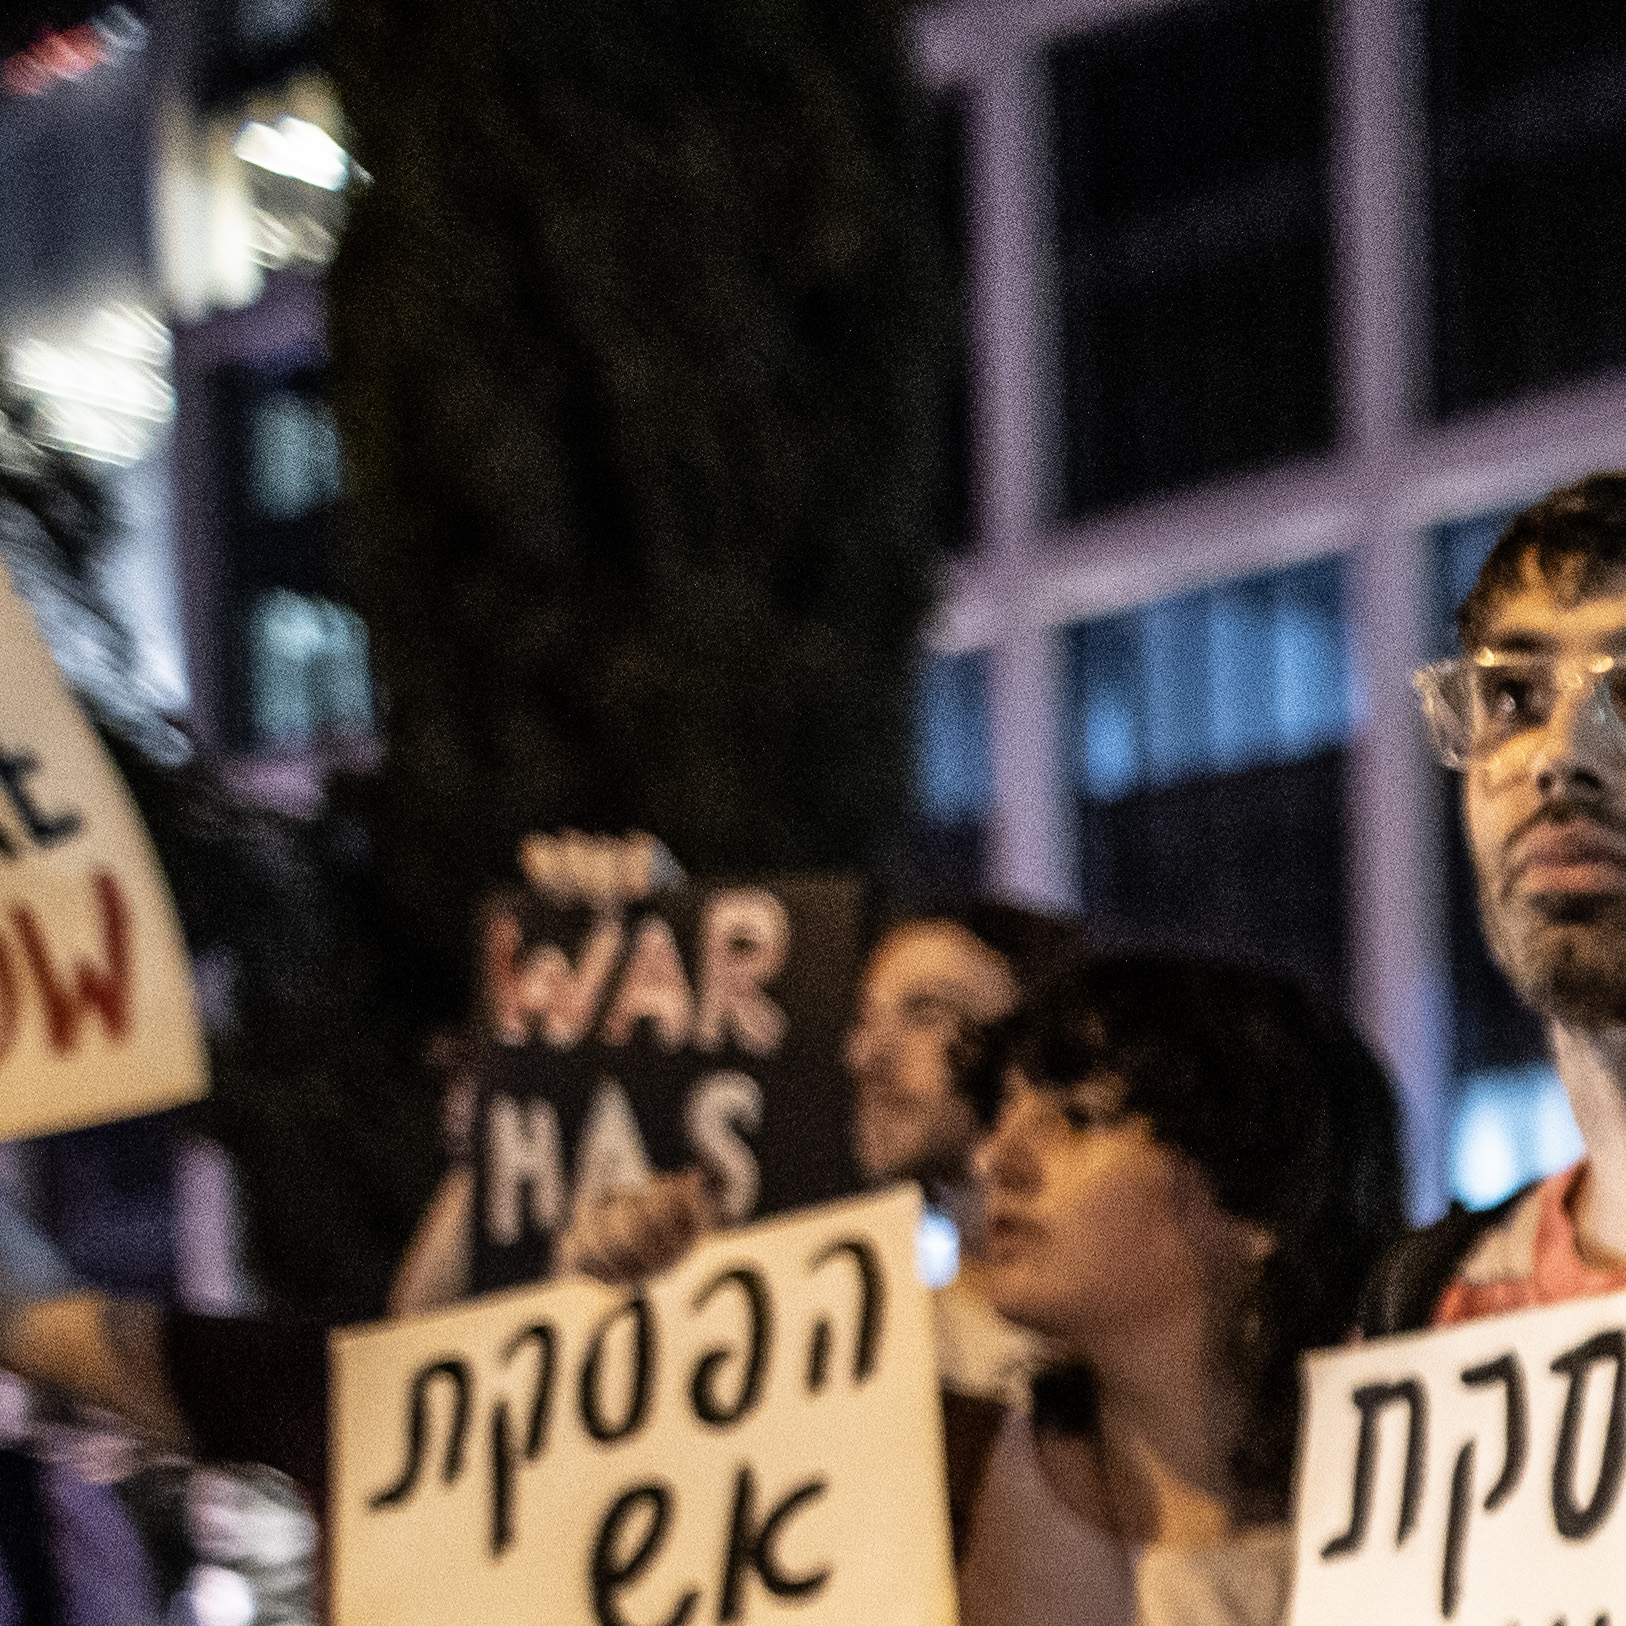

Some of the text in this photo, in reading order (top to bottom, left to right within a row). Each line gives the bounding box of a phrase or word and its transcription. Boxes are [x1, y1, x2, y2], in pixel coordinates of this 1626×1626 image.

[480, 886, 794, 1062] WAR
[484, 1068, 766, 1246] HAS
[368, 1228, 886, 1560] הפסקת
